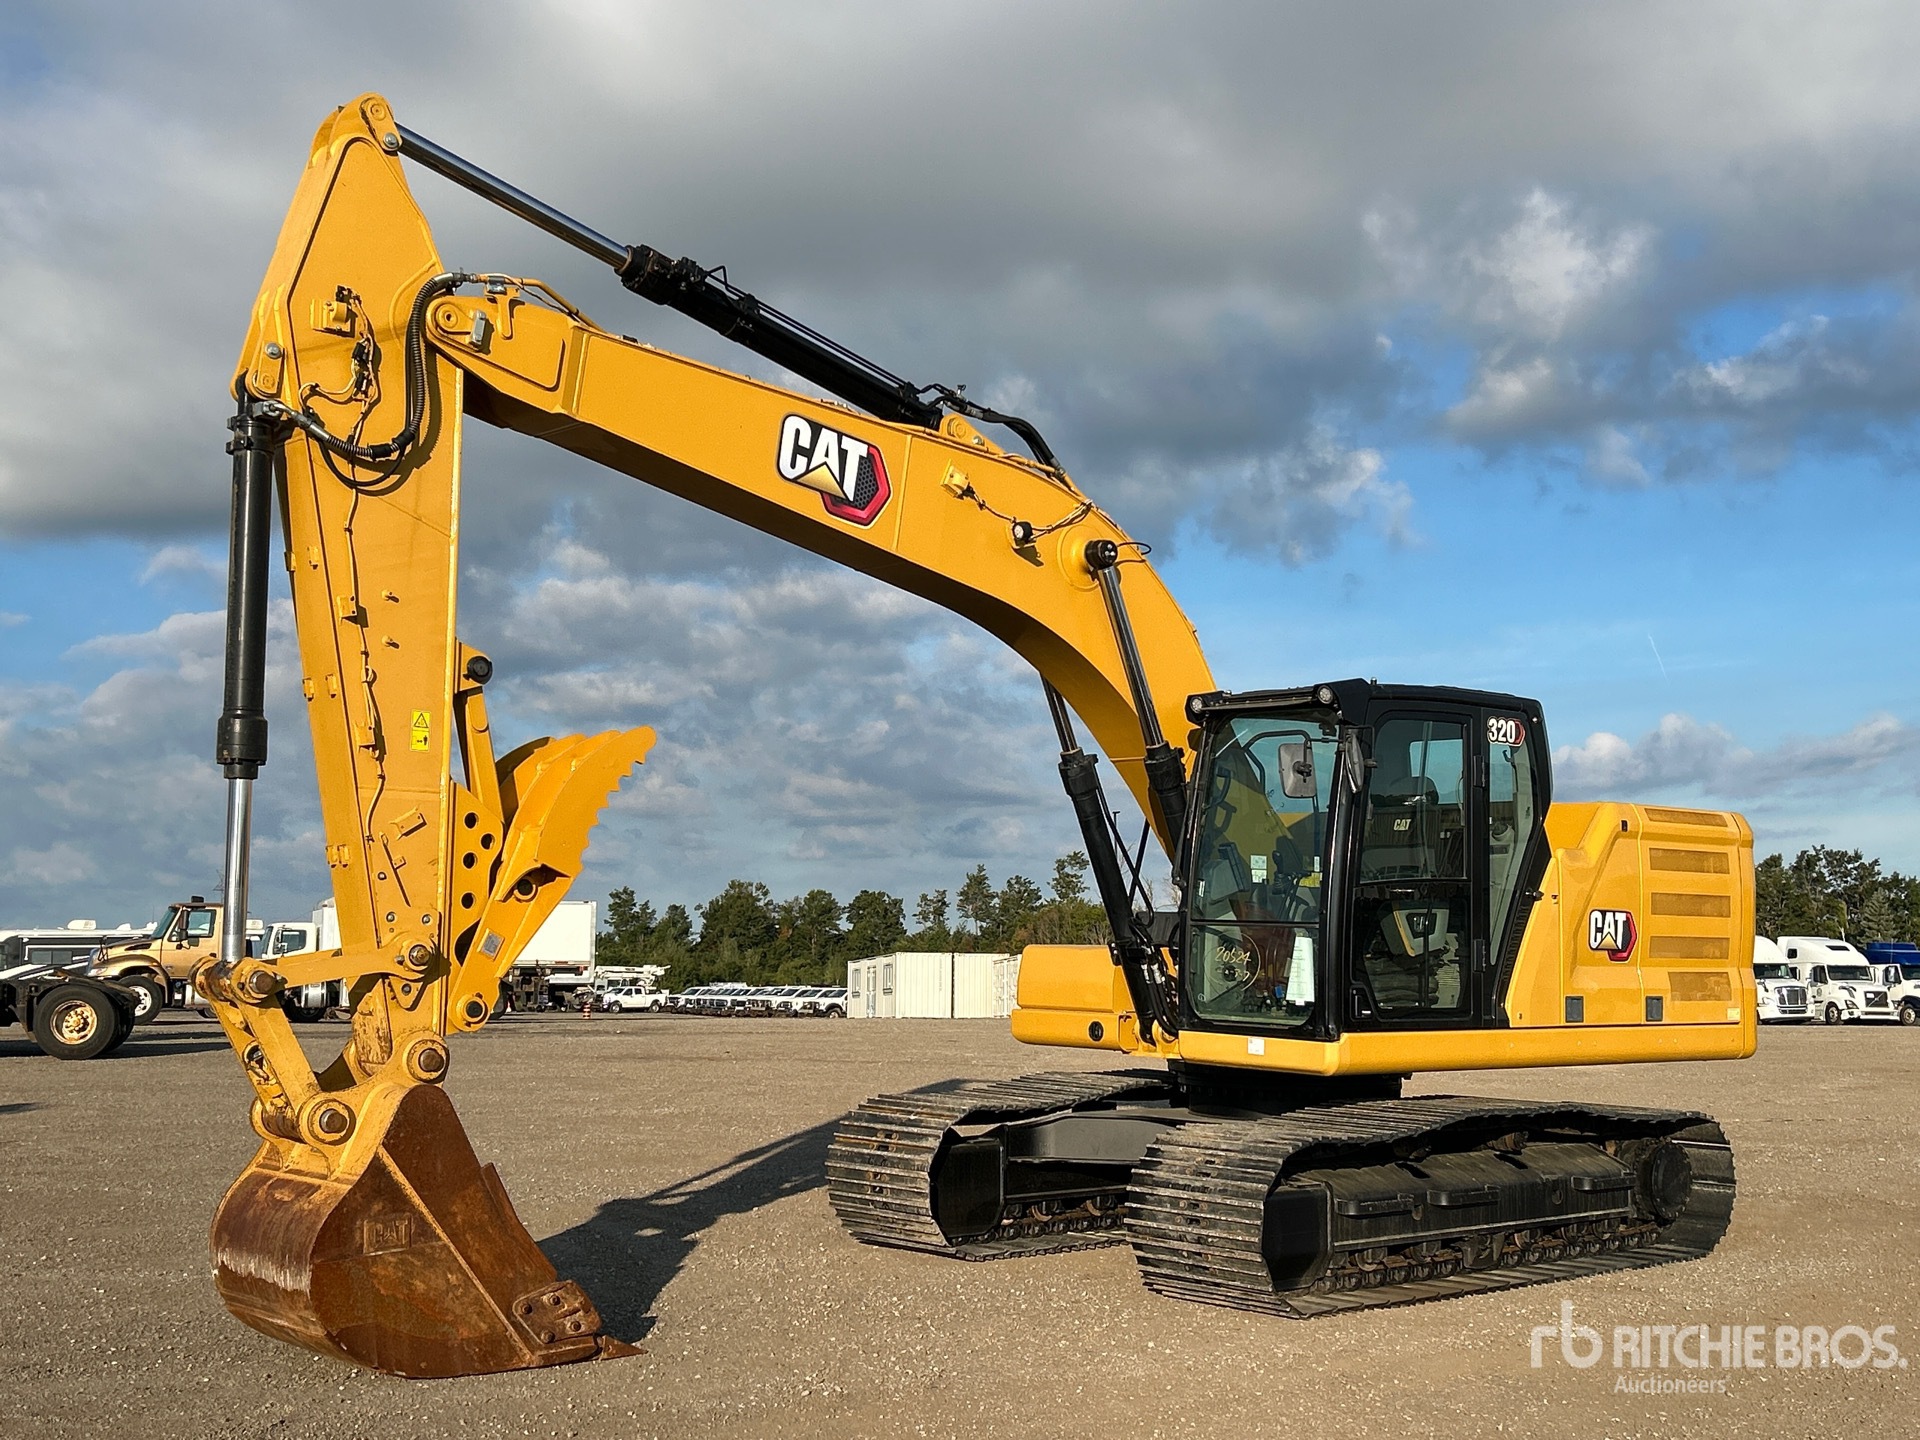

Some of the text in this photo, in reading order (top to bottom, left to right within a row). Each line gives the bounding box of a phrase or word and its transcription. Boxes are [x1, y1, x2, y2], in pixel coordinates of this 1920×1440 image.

[779, 415, 869, 502] CAT
[1489, 718, 1516, 743] 320
[1393, 819, 1412, 831] CAT
[1590, 910, 1627, 950] CAT
